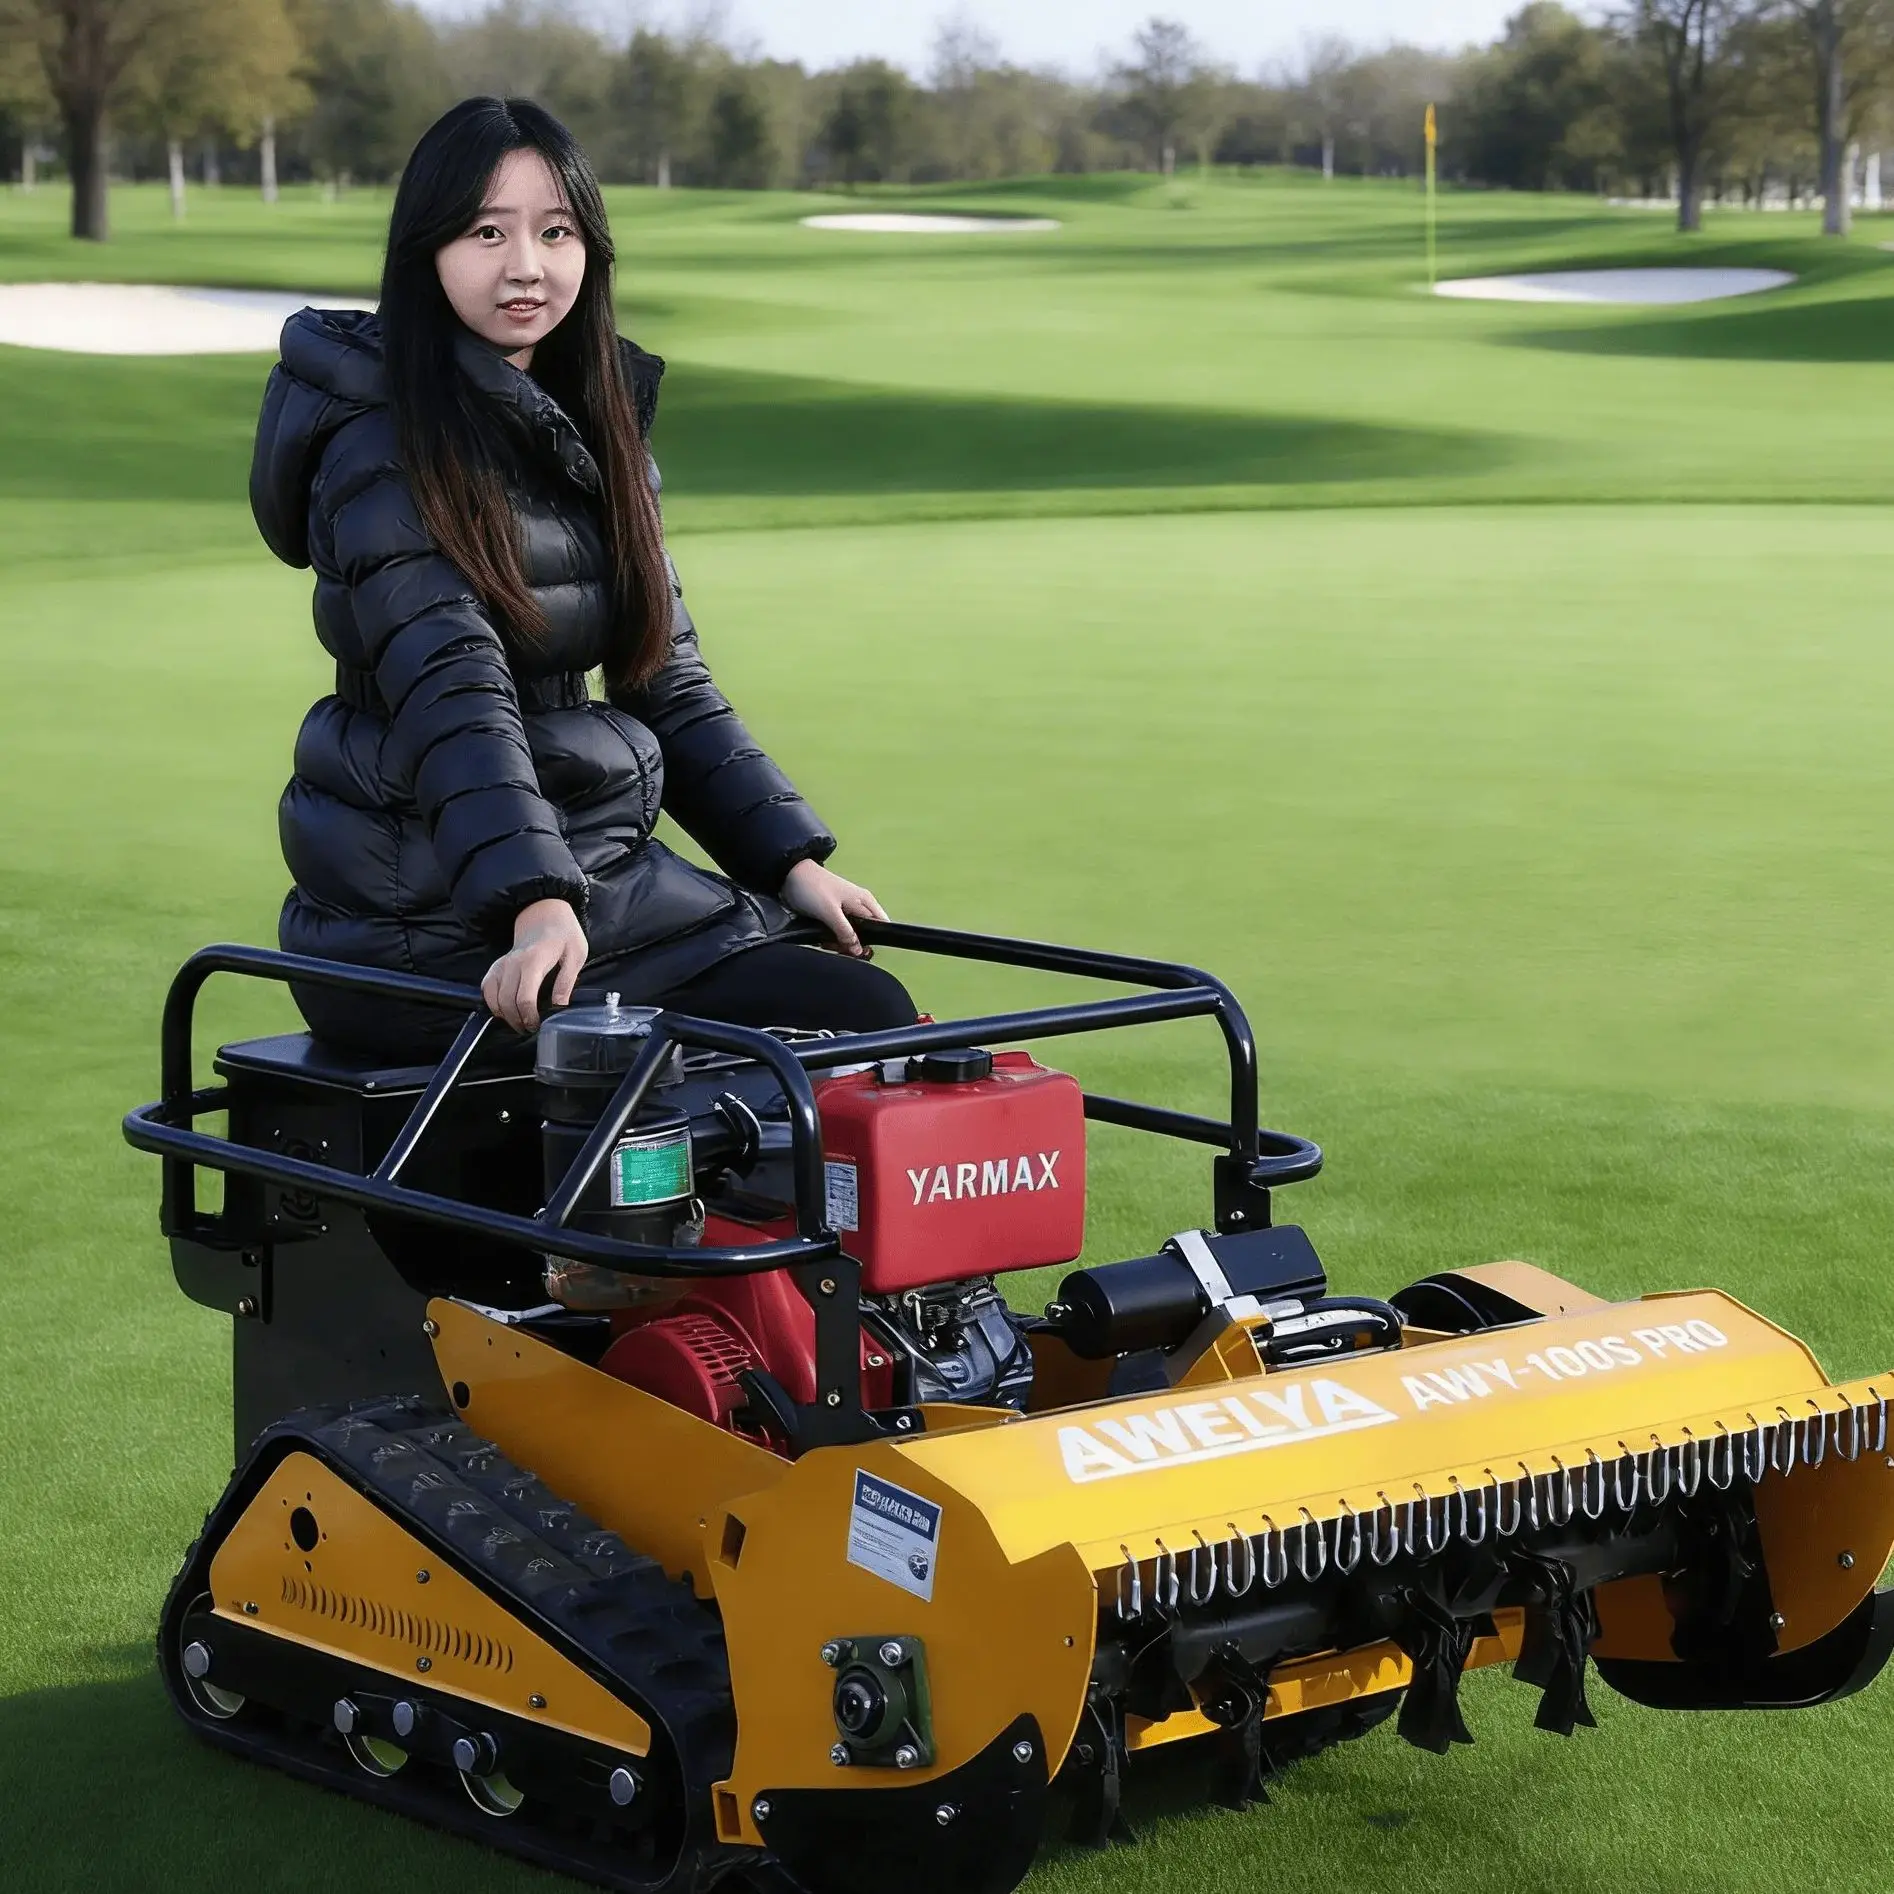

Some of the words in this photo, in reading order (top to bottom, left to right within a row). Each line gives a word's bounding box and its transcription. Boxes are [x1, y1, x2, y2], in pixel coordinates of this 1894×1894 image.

[906, 1150, 1060, 1206] YARMAX
[1057, 1379, 1397, 1483] AWELYA
[1400, 1336, 1643, 1411] AWY-100S
[1631, 1319, 1729, 1359] PRO
